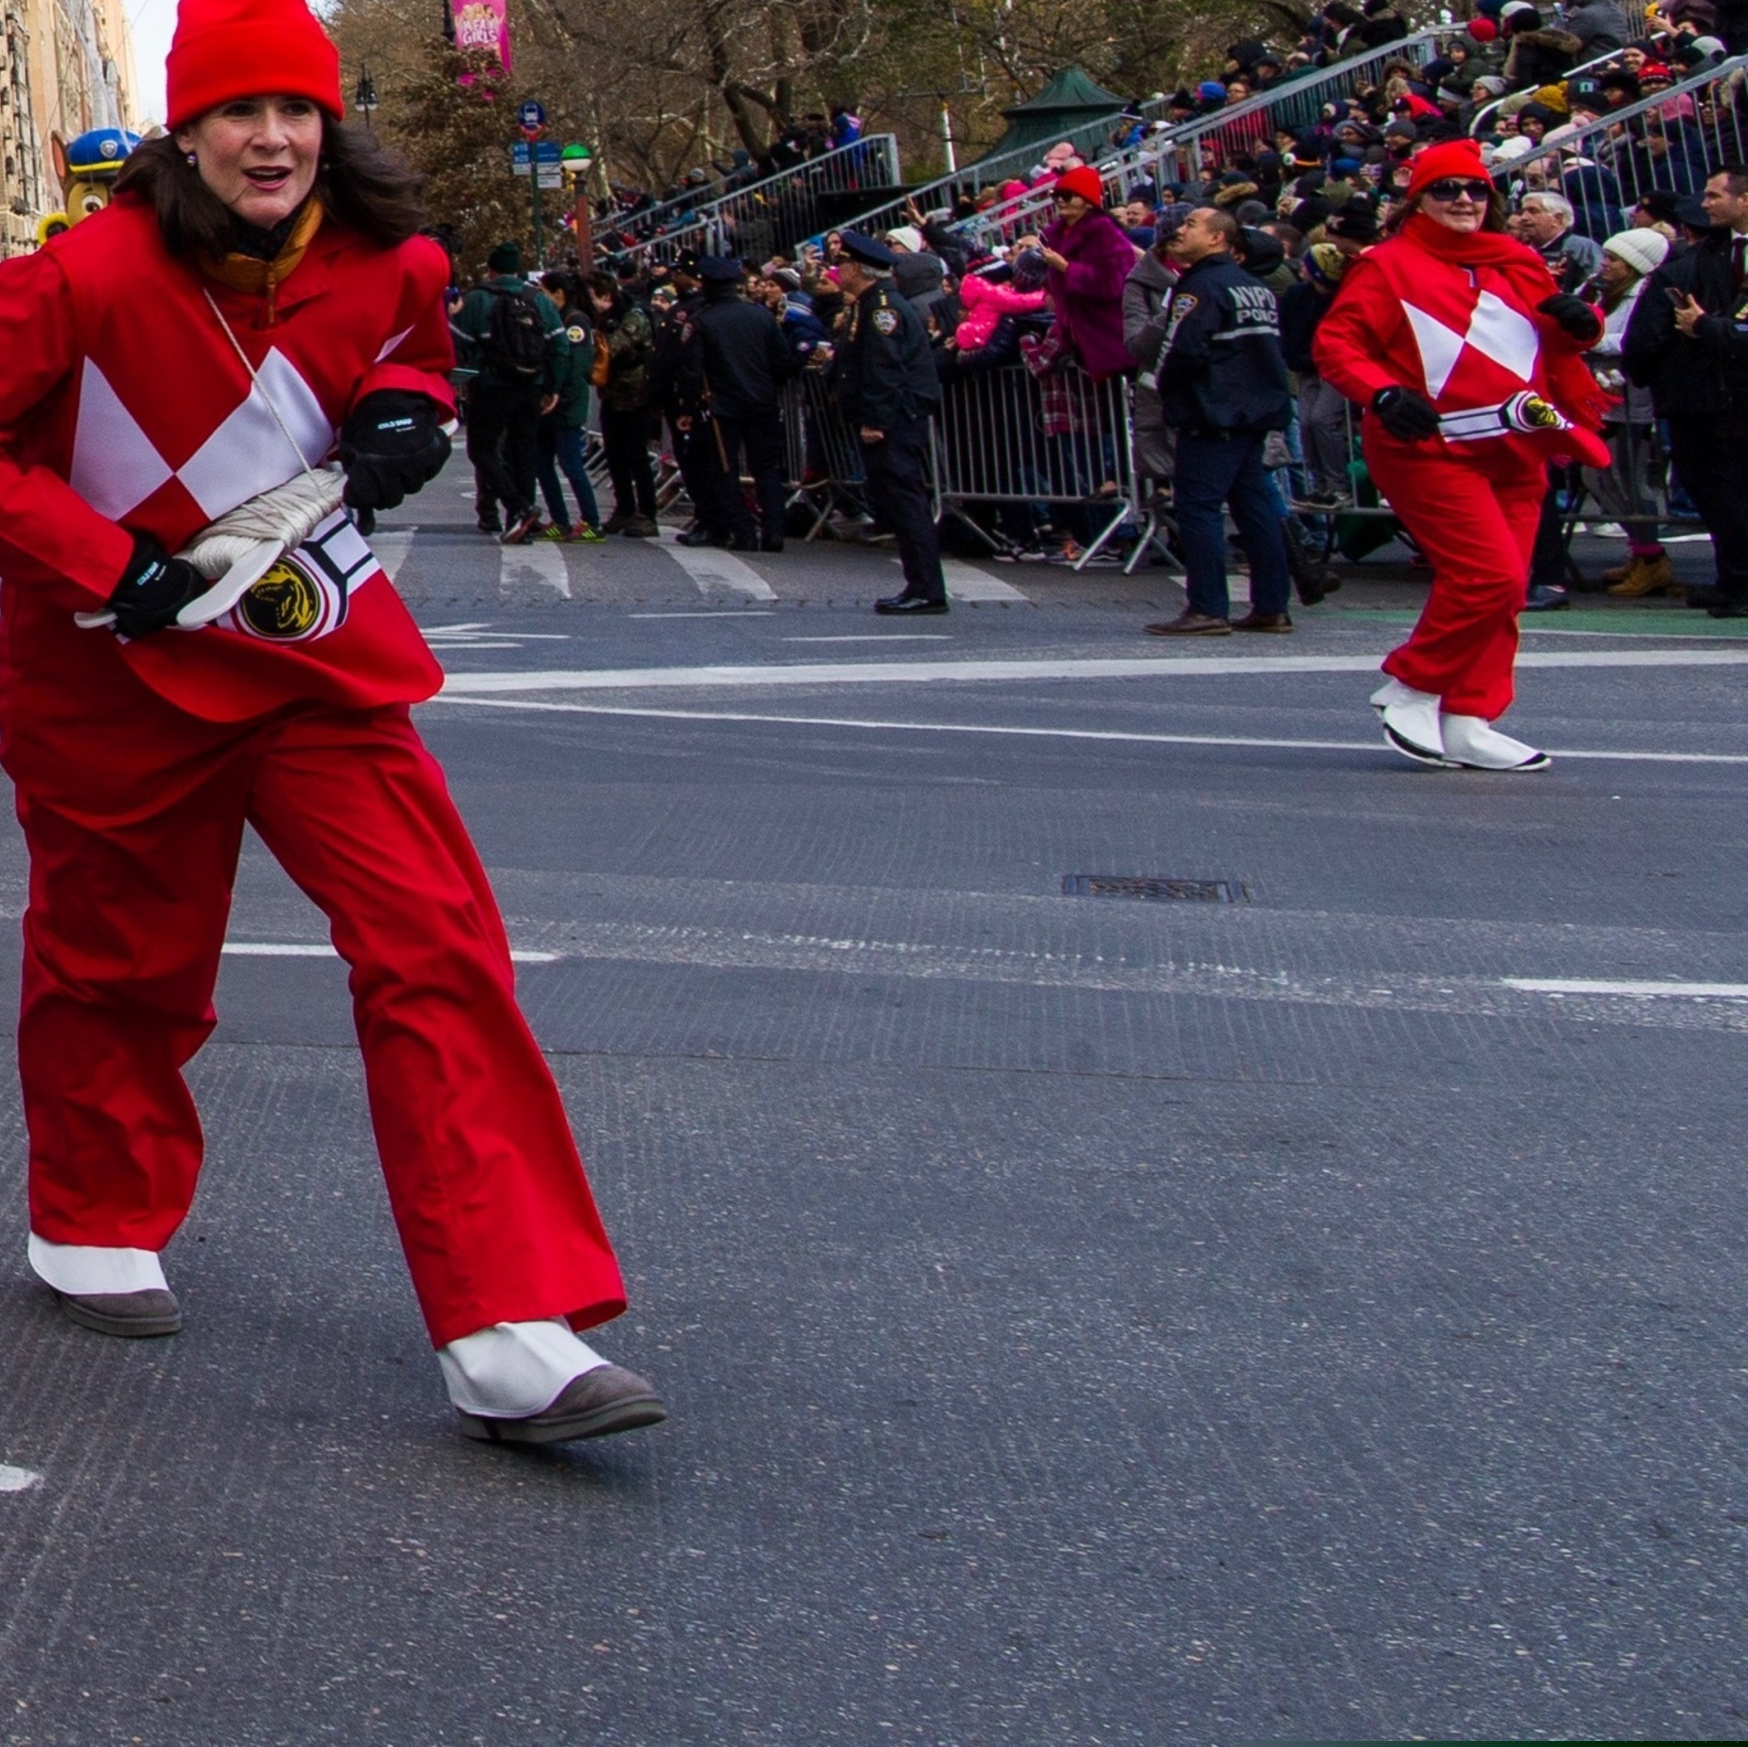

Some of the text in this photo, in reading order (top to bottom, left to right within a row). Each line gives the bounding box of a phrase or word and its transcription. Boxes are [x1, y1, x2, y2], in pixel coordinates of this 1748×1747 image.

[463, 29, 498, 46] GIRLS
[1228, 286, 1277, 310] NYPD
[1236, 308, 1279, 325] POLIC
